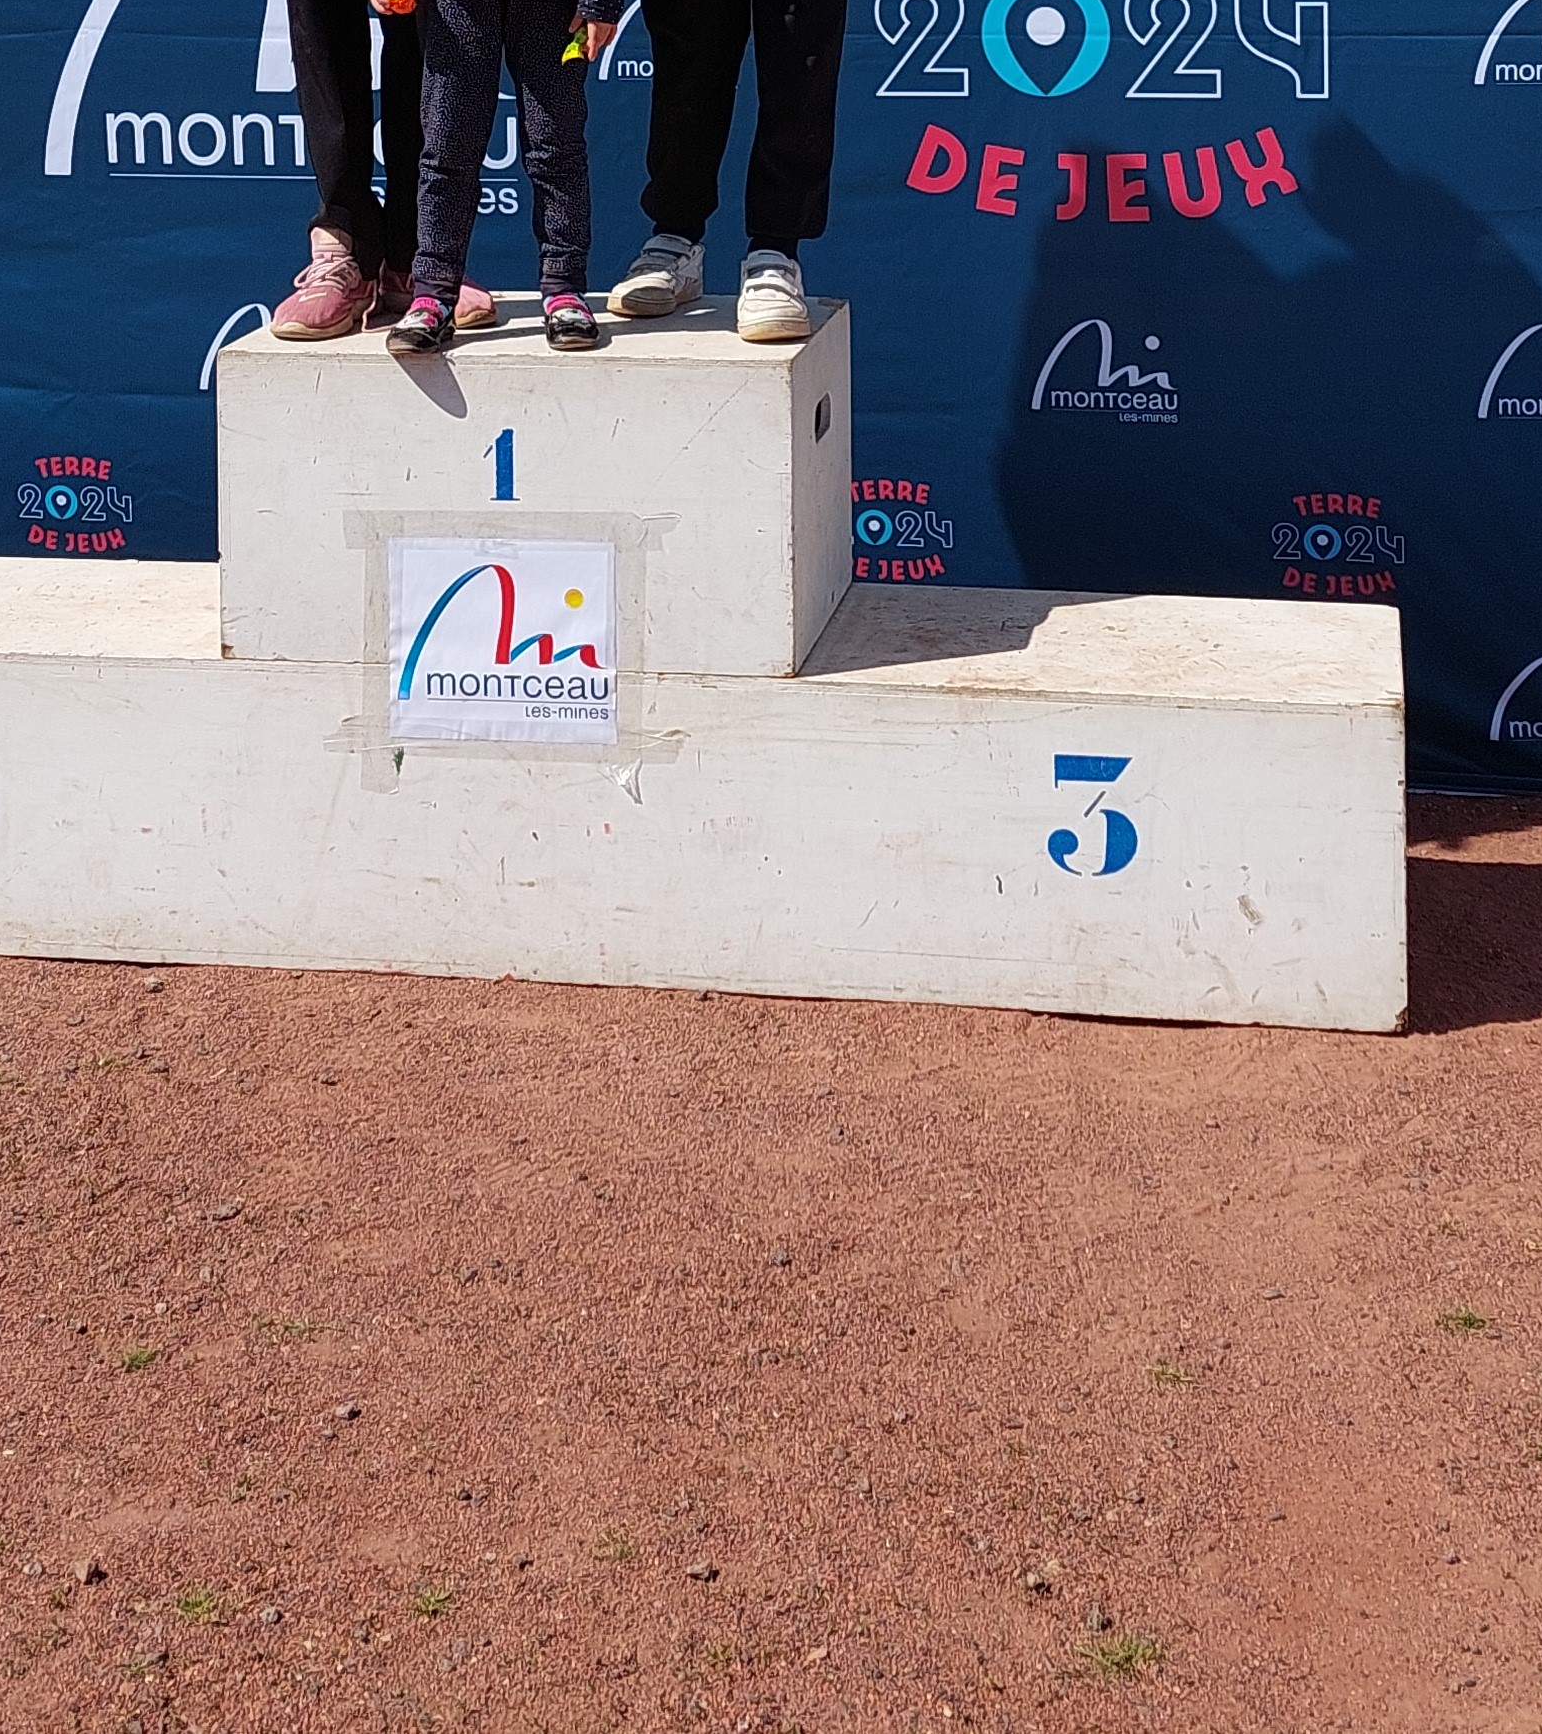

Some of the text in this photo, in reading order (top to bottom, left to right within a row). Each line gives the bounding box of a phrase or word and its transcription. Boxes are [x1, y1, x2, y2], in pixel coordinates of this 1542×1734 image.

[905, 123, 1300, 223] DE JEUX
[34, 456, 111, 481] TERRE
[483, 428, 521, 502] 1
[17, 483, 133, 522] 2024
[1292, 493, 1381, 518] TERRE
[27, 524, 126, 553] DE JEUX
[851, 509, 953, 548] 024
[1271, 522, 1405, 564] 2024
[878, 554, 946, 581] JEUX
[1282, 566, 1396, 596] DE JEUX
[1047, 753, 1139, 877] 3
